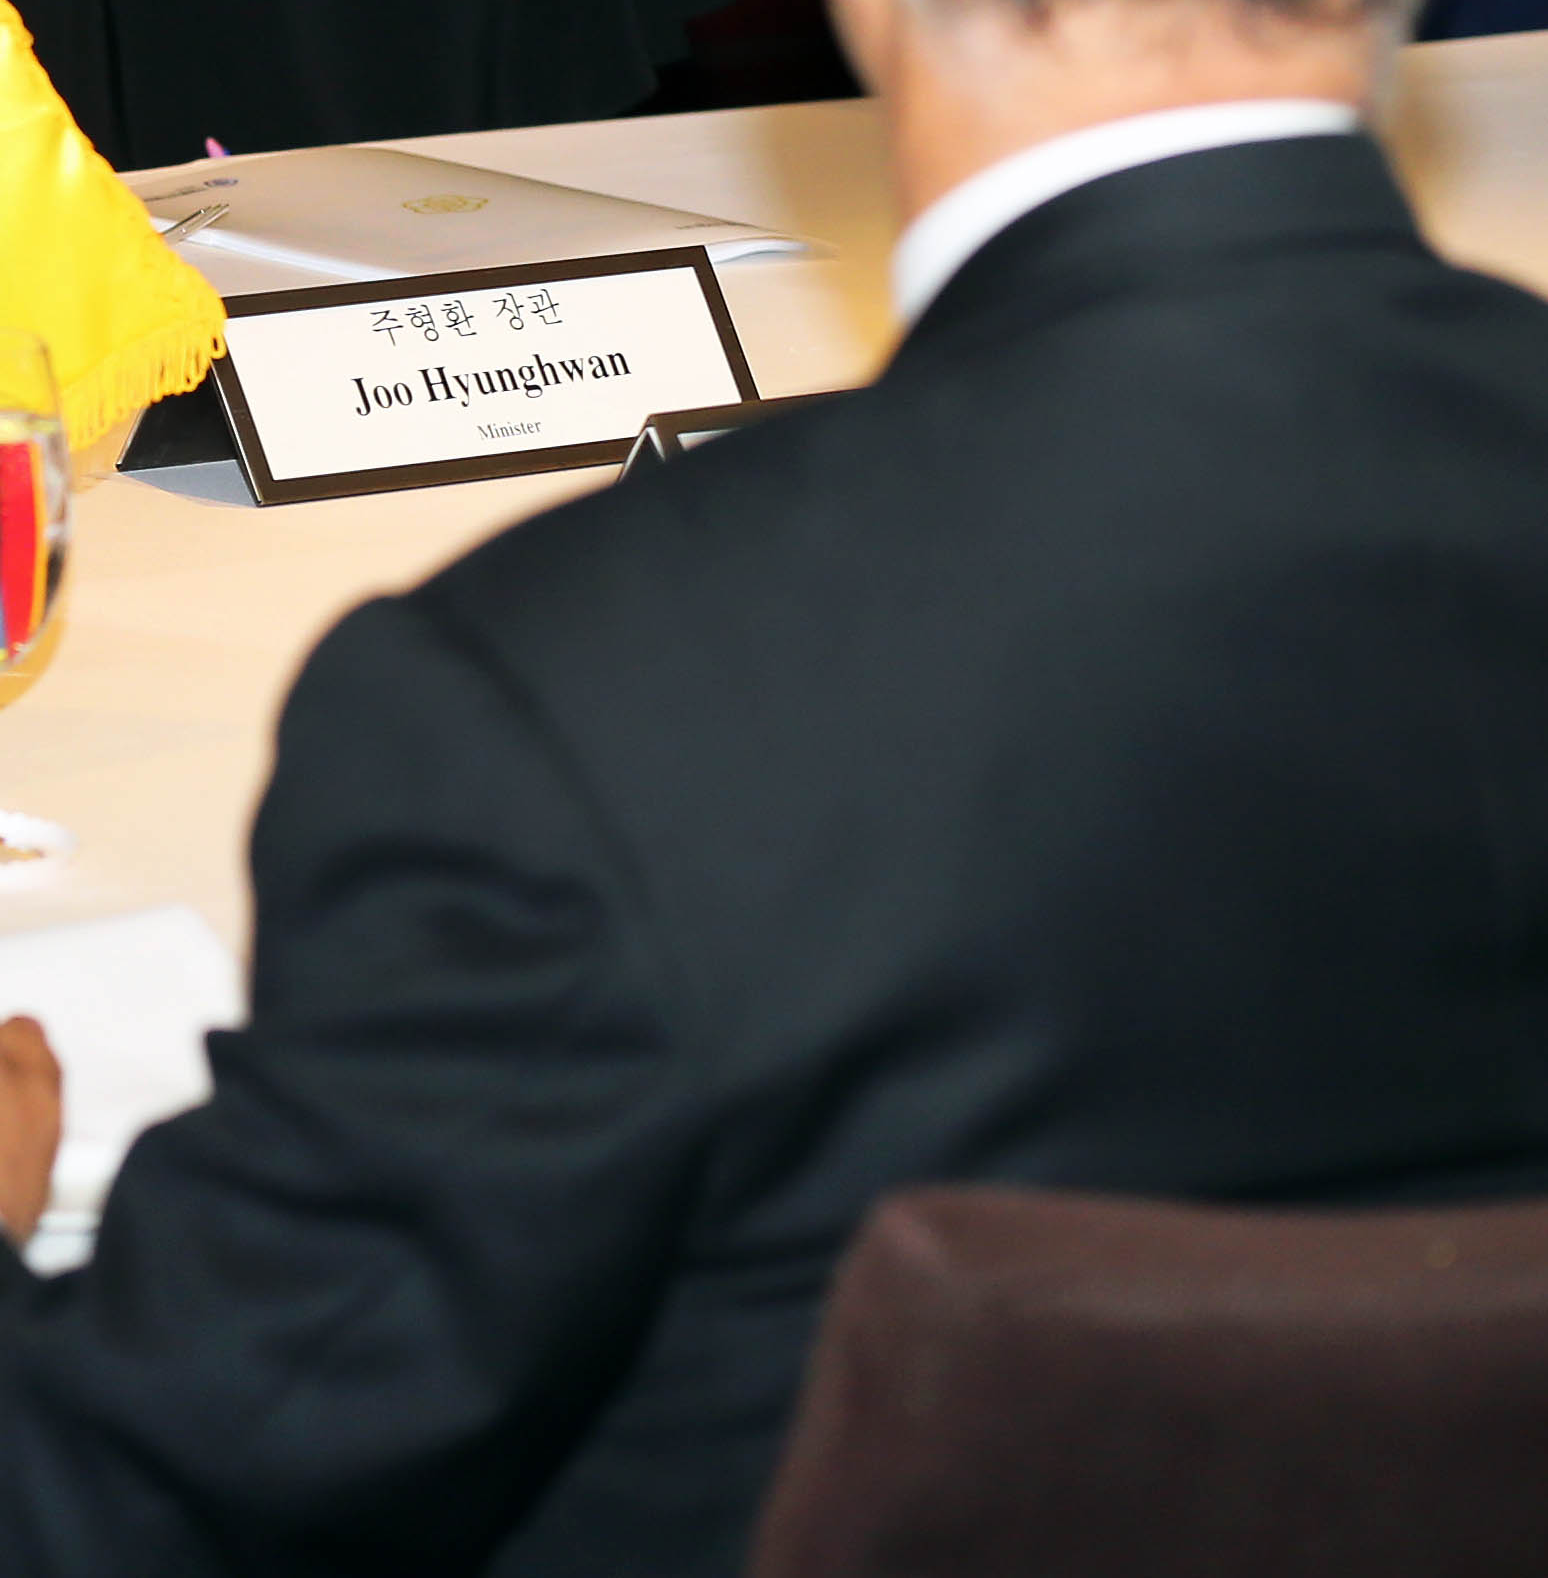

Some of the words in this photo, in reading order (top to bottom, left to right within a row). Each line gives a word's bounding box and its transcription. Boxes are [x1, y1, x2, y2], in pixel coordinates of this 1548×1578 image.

[368, 299, 479, 347] 주형환
[491, 288, 564, 331] 장관
[350, 376, 413, 417] Joo
[417, 350, 632, 408] Hyunghwan
[476, 419, 543, 441] Minister
